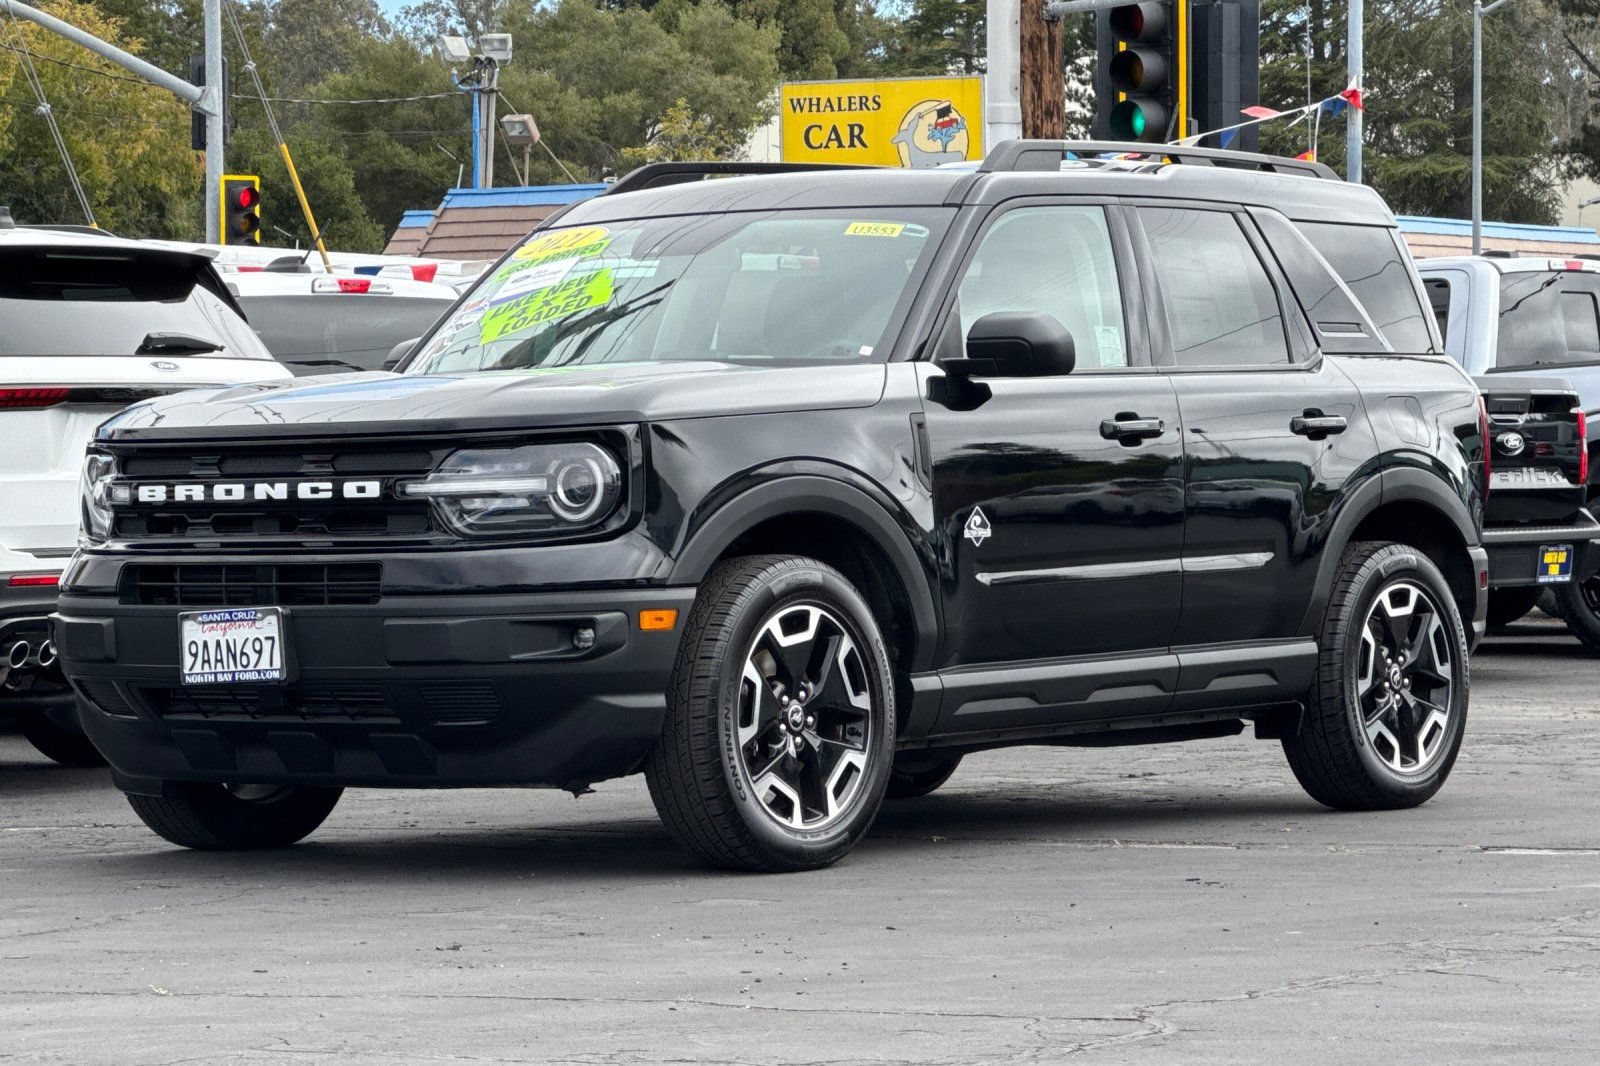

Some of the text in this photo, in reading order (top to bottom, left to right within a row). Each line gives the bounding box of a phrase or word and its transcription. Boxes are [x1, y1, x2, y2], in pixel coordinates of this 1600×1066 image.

[789, 95, 881, 114] WHALERS
[803, 123, 868, 150] CAR
[852, 225, 897, 236] U3553
[537, 241, 605, 265] ARRIVED
[489, 290, 541, 321] LIKE
[546, 271, 603, 298] NEW
[507, 304, 528, 321] 4
[566, 287, 586, 300] 4
[497, 294, 593, 337] LOADED
[138, 481, 380, 502] BRONCO
[202, 611, 256, 622] SANTA CRUZ
[201, 620, 261, 637] California
[188, 636, 276, 672] 9AAN697
[185, 670, 280, 684] NORTH BAY FORD.COM
